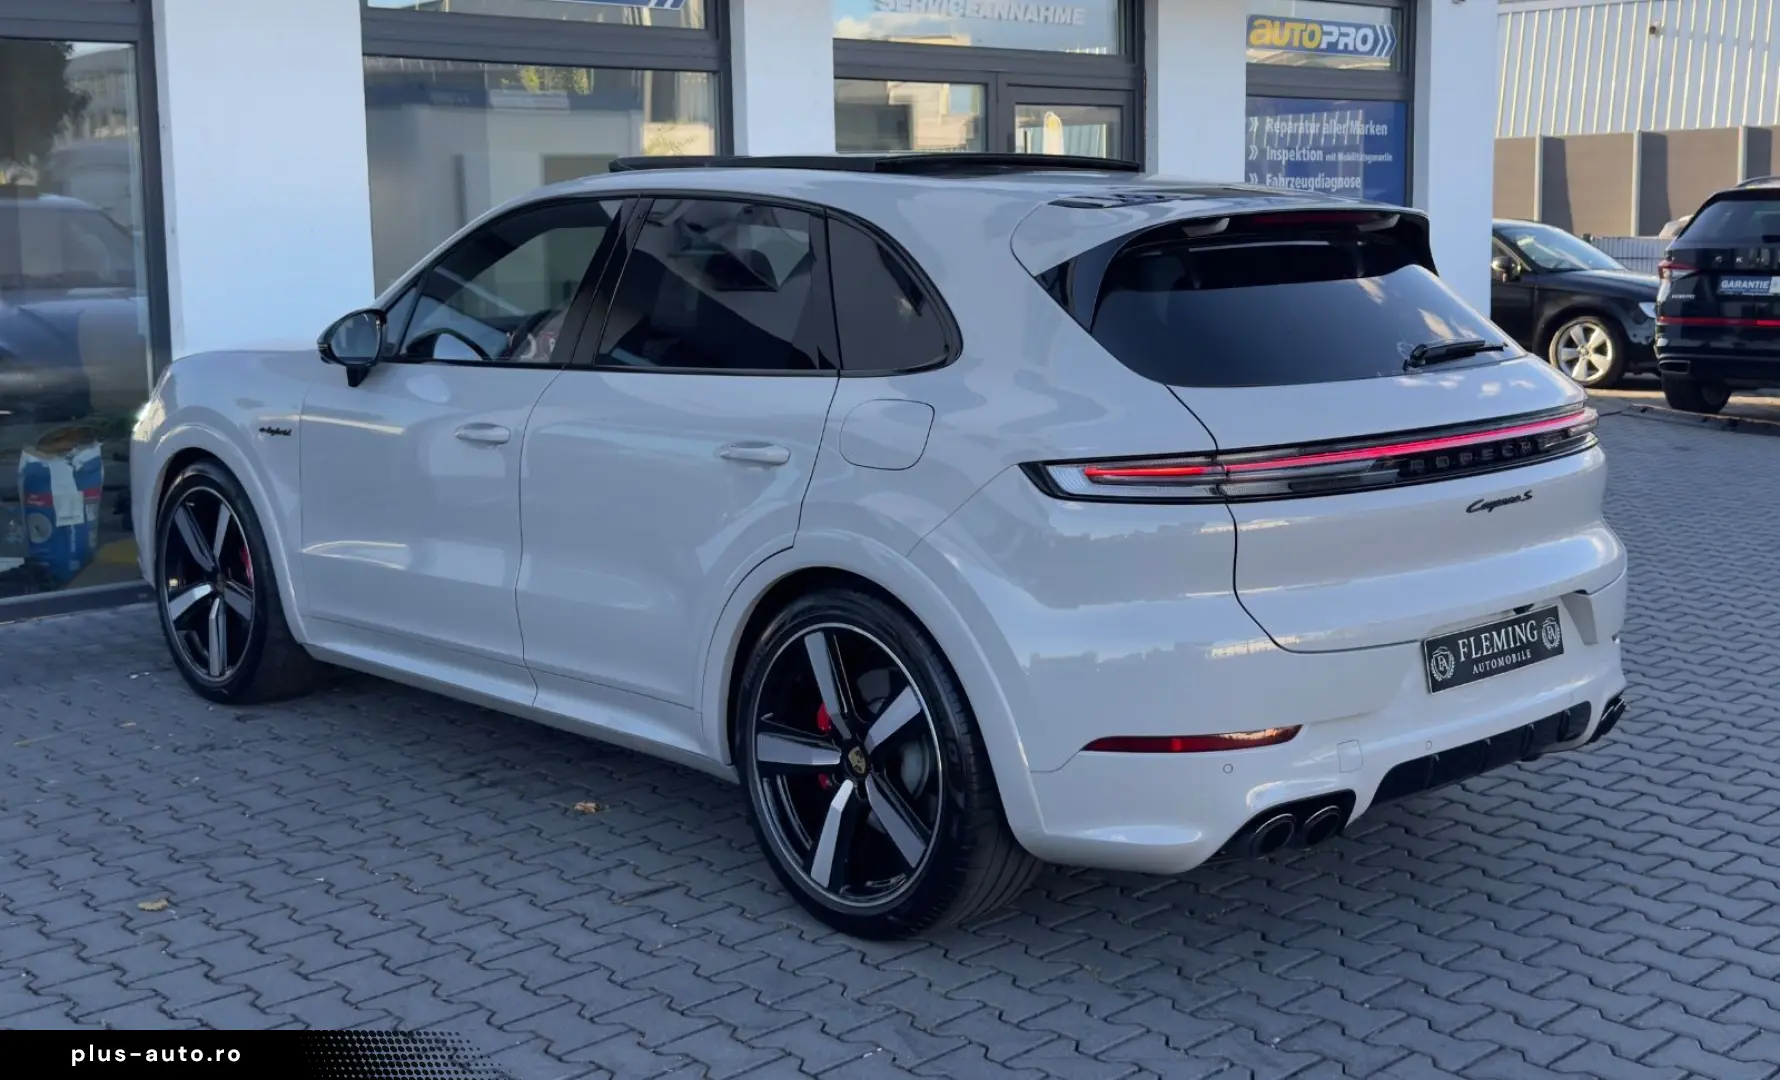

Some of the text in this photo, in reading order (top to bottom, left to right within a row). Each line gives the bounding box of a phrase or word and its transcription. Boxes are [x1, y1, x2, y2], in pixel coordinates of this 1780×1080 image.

[1266, 116, 1388, 137] Reparatur aller Marken
[1266, 147, 1323, 165] Inspektion
[1266, 172, 1361, 192] Fahrzeugdiagnose
[1721, 279, 1770, 289] GARANTIE
[1457, 620, 1538, 662] FLEMING
[1472, 649, 1532, 674] AUTOMOBILE
